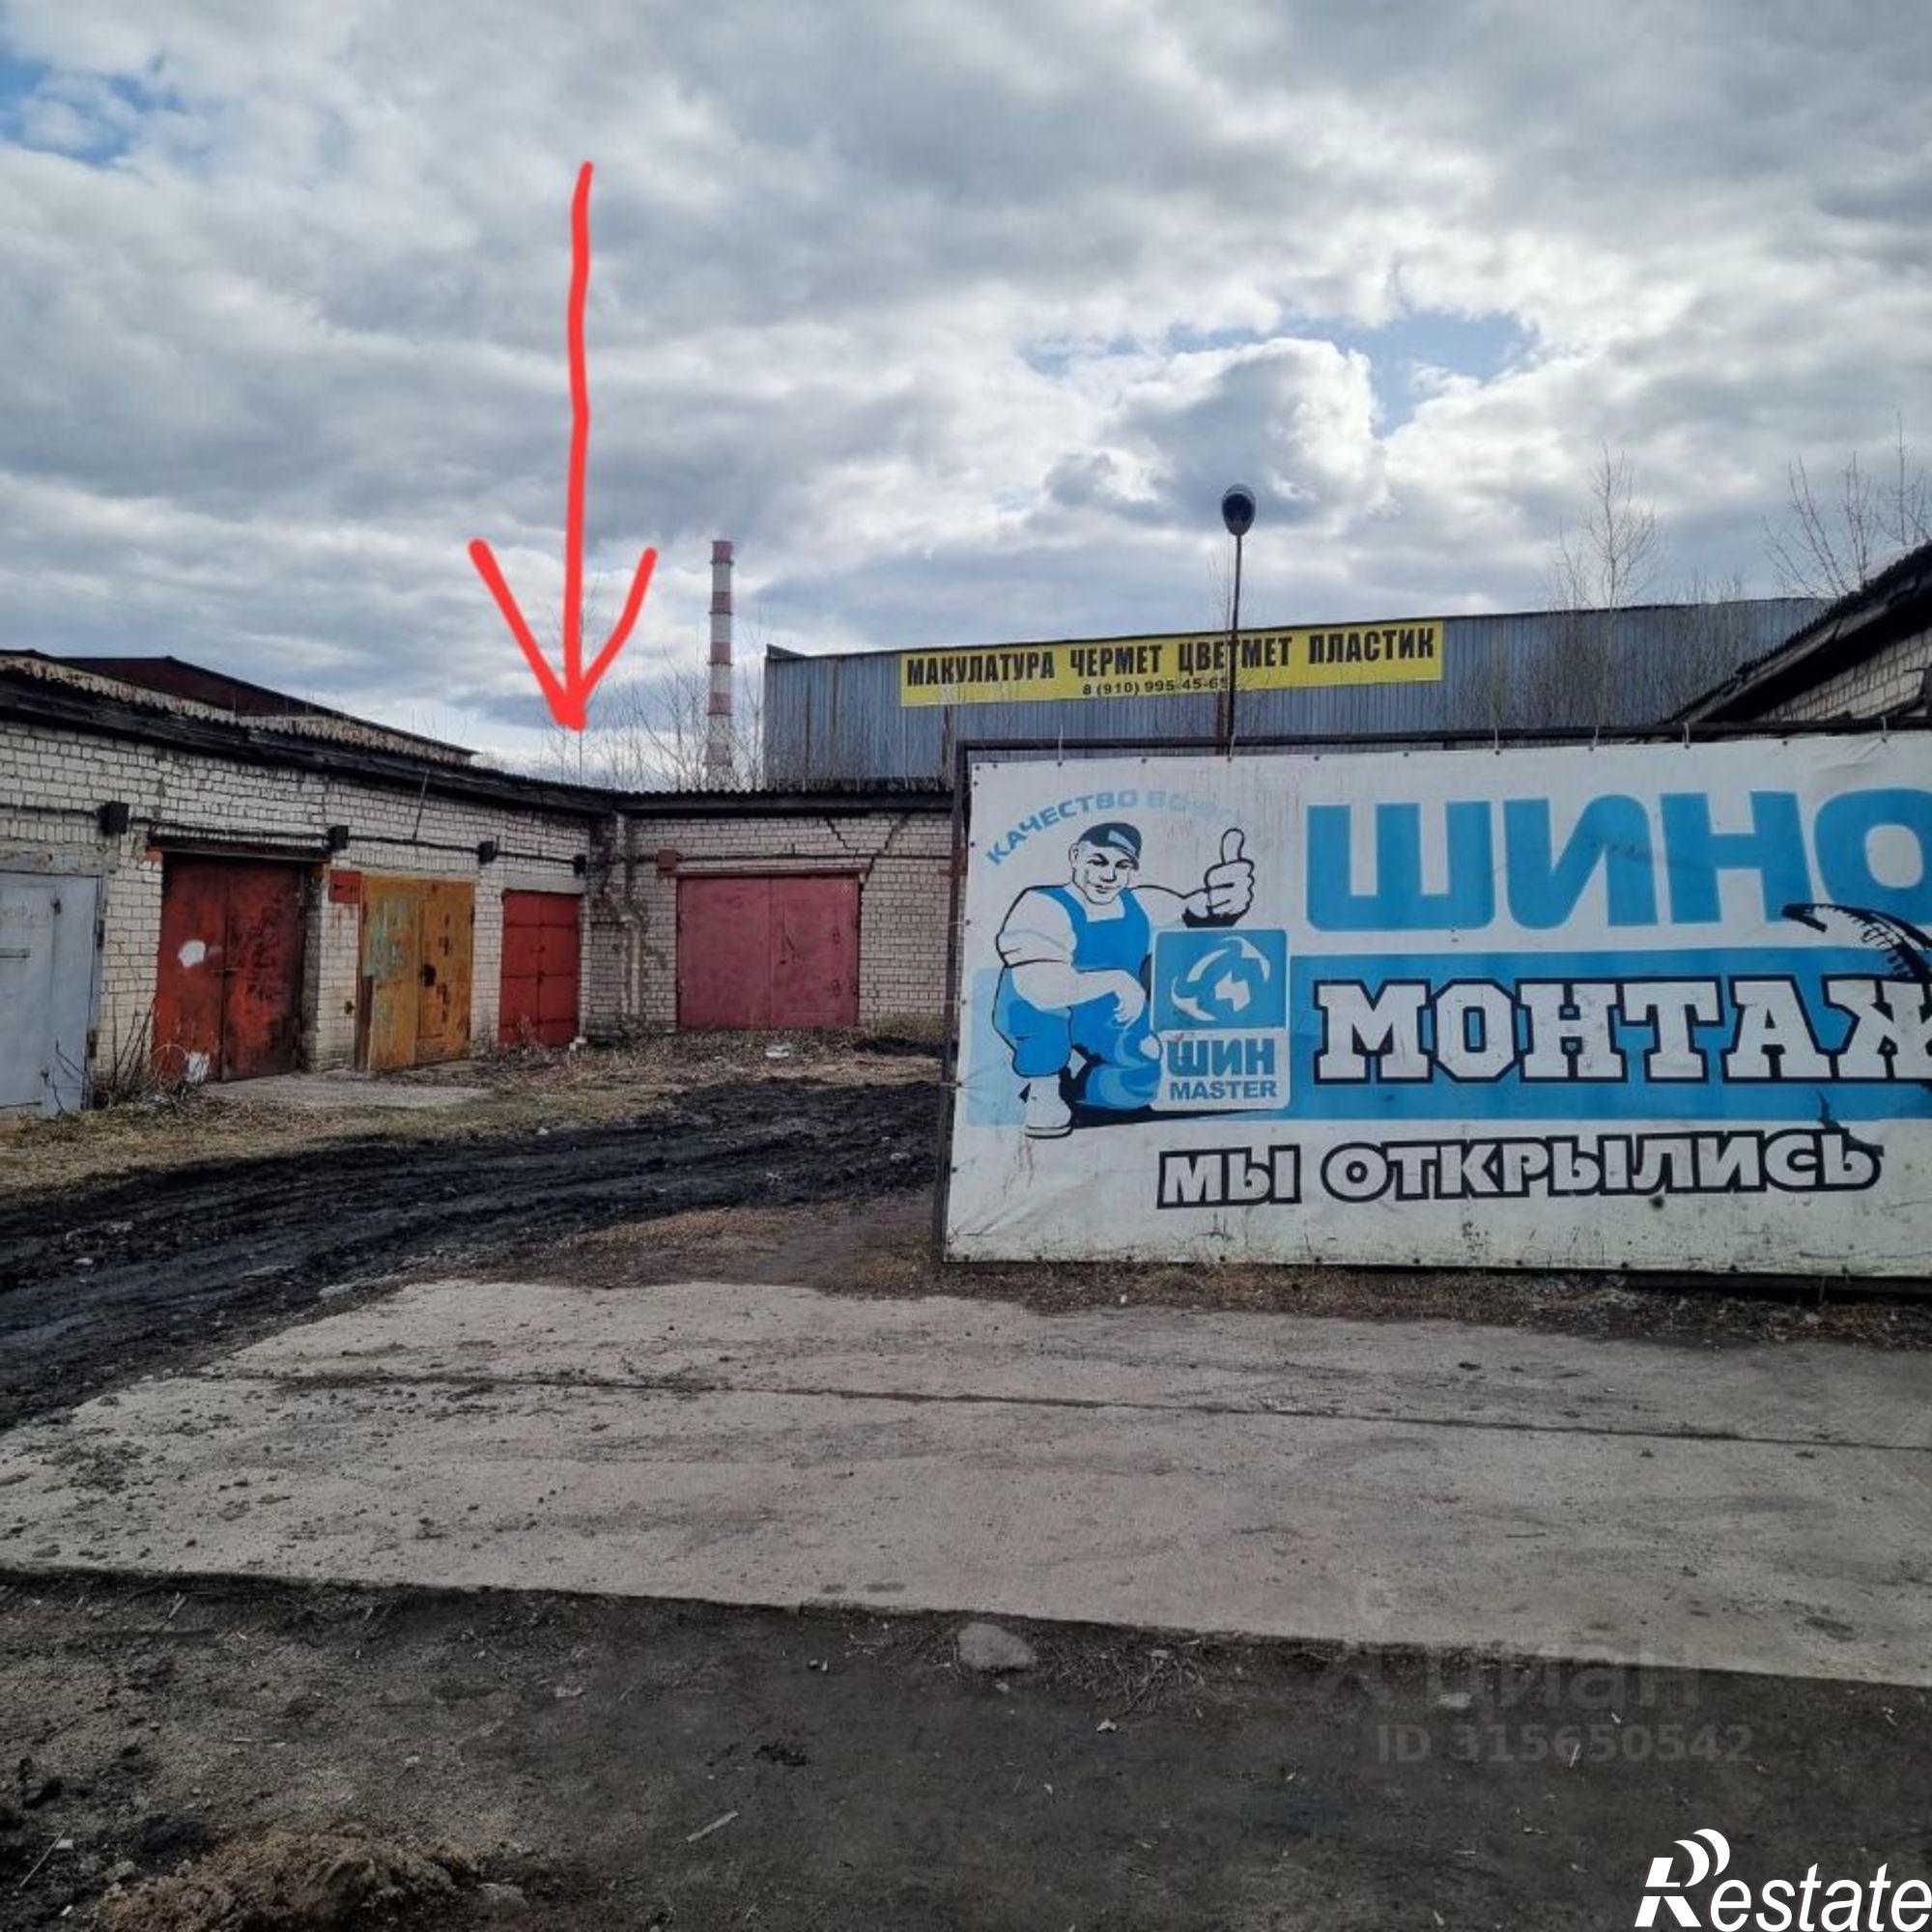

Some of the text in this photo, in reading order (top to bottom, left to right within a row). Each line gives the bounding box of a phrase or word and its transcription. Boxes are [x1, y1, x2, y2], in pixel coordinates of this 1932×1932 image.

[906, 627, 1435, 687] МАКУЛАТУРА ЧЕРМЕТ ЦВЕТМЕТ ПЛАСТИК
[1082, 684, 1092, 696] 8
[1096, 682, 1140, 696] (910)
[985, 788, 1138, 866] КАЧЕСТВО
[1307, 788, 1932, 931] ШИНО
[1167, 1037, 1275, 1077] ШИН
[1170, 1080, 1277, 1100] MASTER
[1156, 1128, 1883, 1208] МЫ ОТКРЫЛИСЬ
